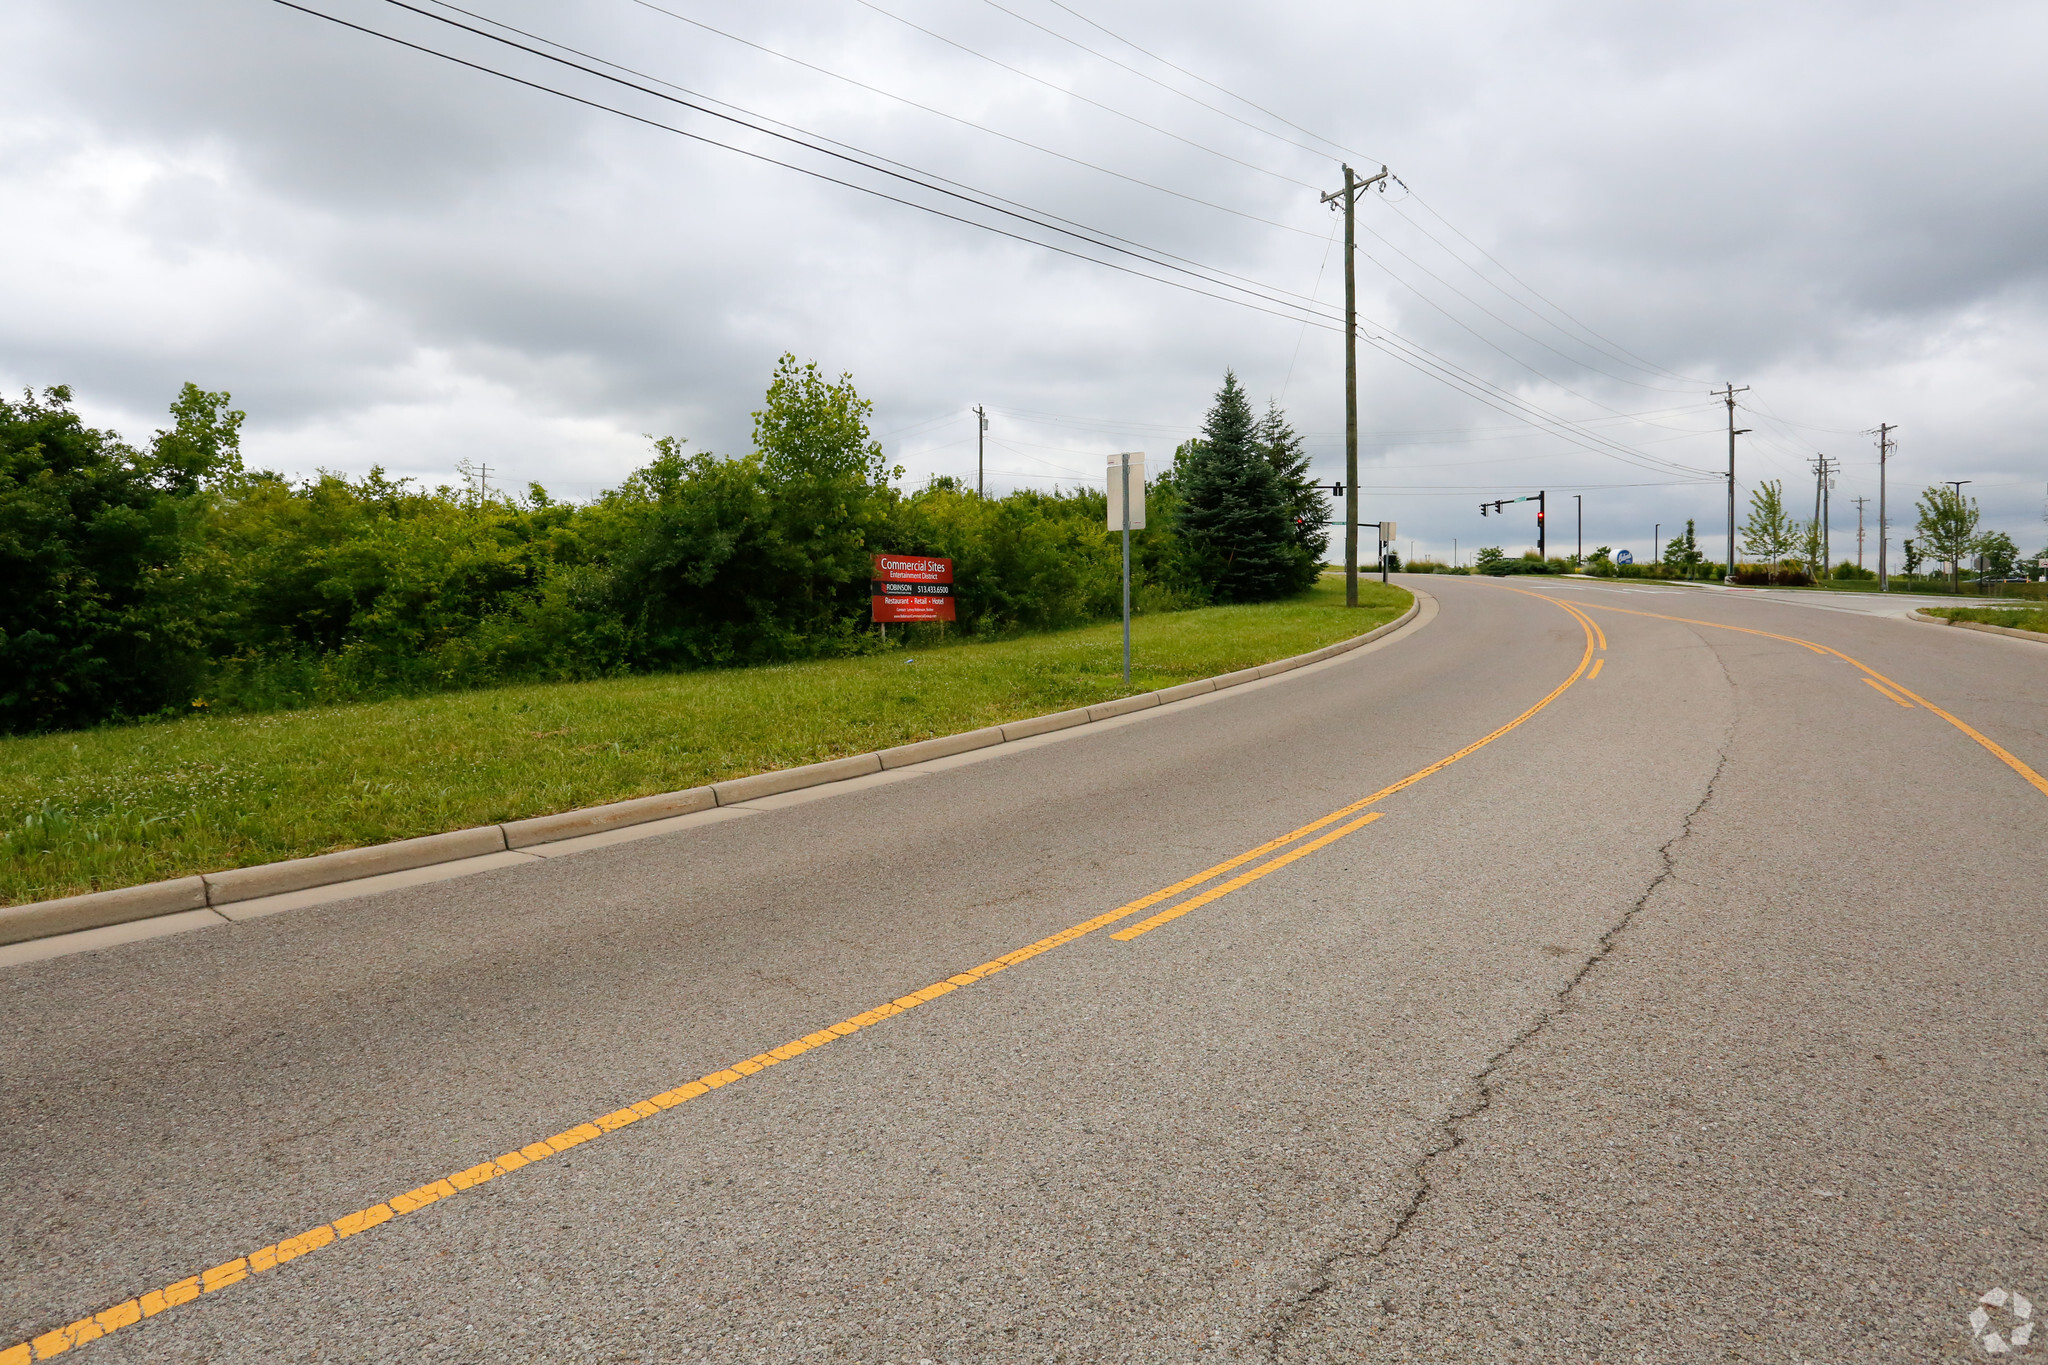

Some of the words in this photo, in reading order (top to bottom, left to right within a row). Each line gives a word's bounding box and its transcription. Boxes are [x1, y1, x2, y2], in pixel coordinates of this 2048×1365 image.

[881, 558, 926, 571] Commercial
[928, 561, 945, 572] Sites
[890, 571, 921, 579] Entertainment
[922, 572, 938, 580] District
